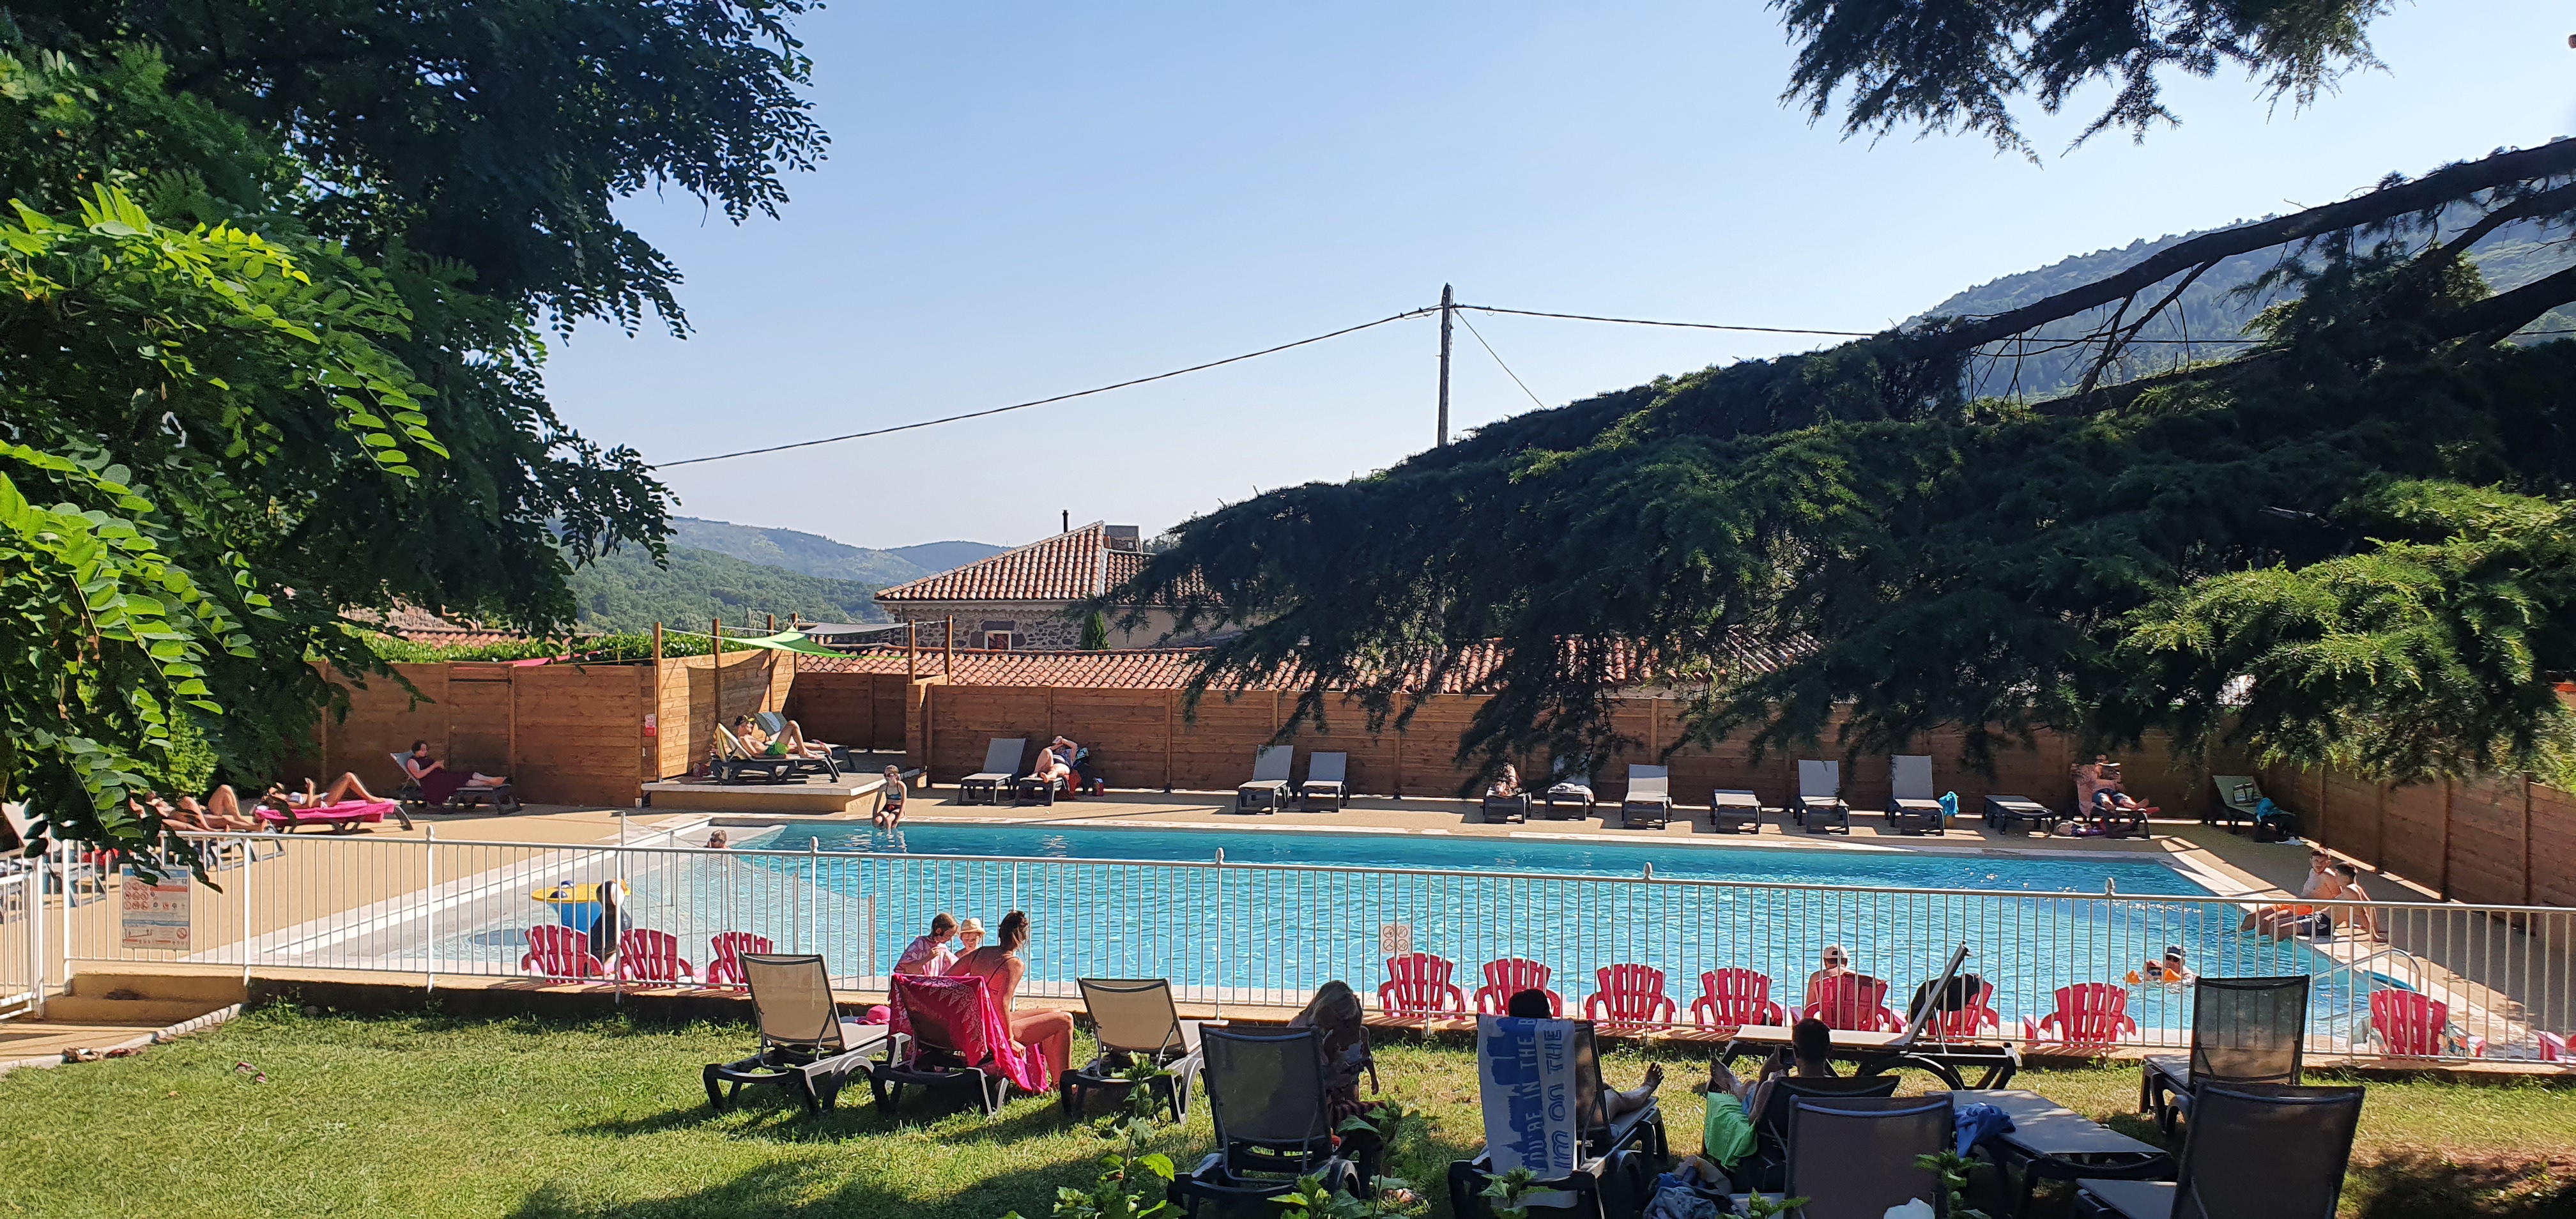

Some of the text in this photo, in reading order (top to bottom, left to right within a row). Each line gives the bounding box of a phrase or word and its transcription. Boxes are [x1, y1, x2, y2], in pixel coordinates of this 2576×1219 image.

[1517, 1036, 1537, 1069] THE
[1544, 1030, 1563, 1074] THE
[1522, 1081, 1540, 1099] IN
[1526, 1110, 1547, 1171] YOU'RE
